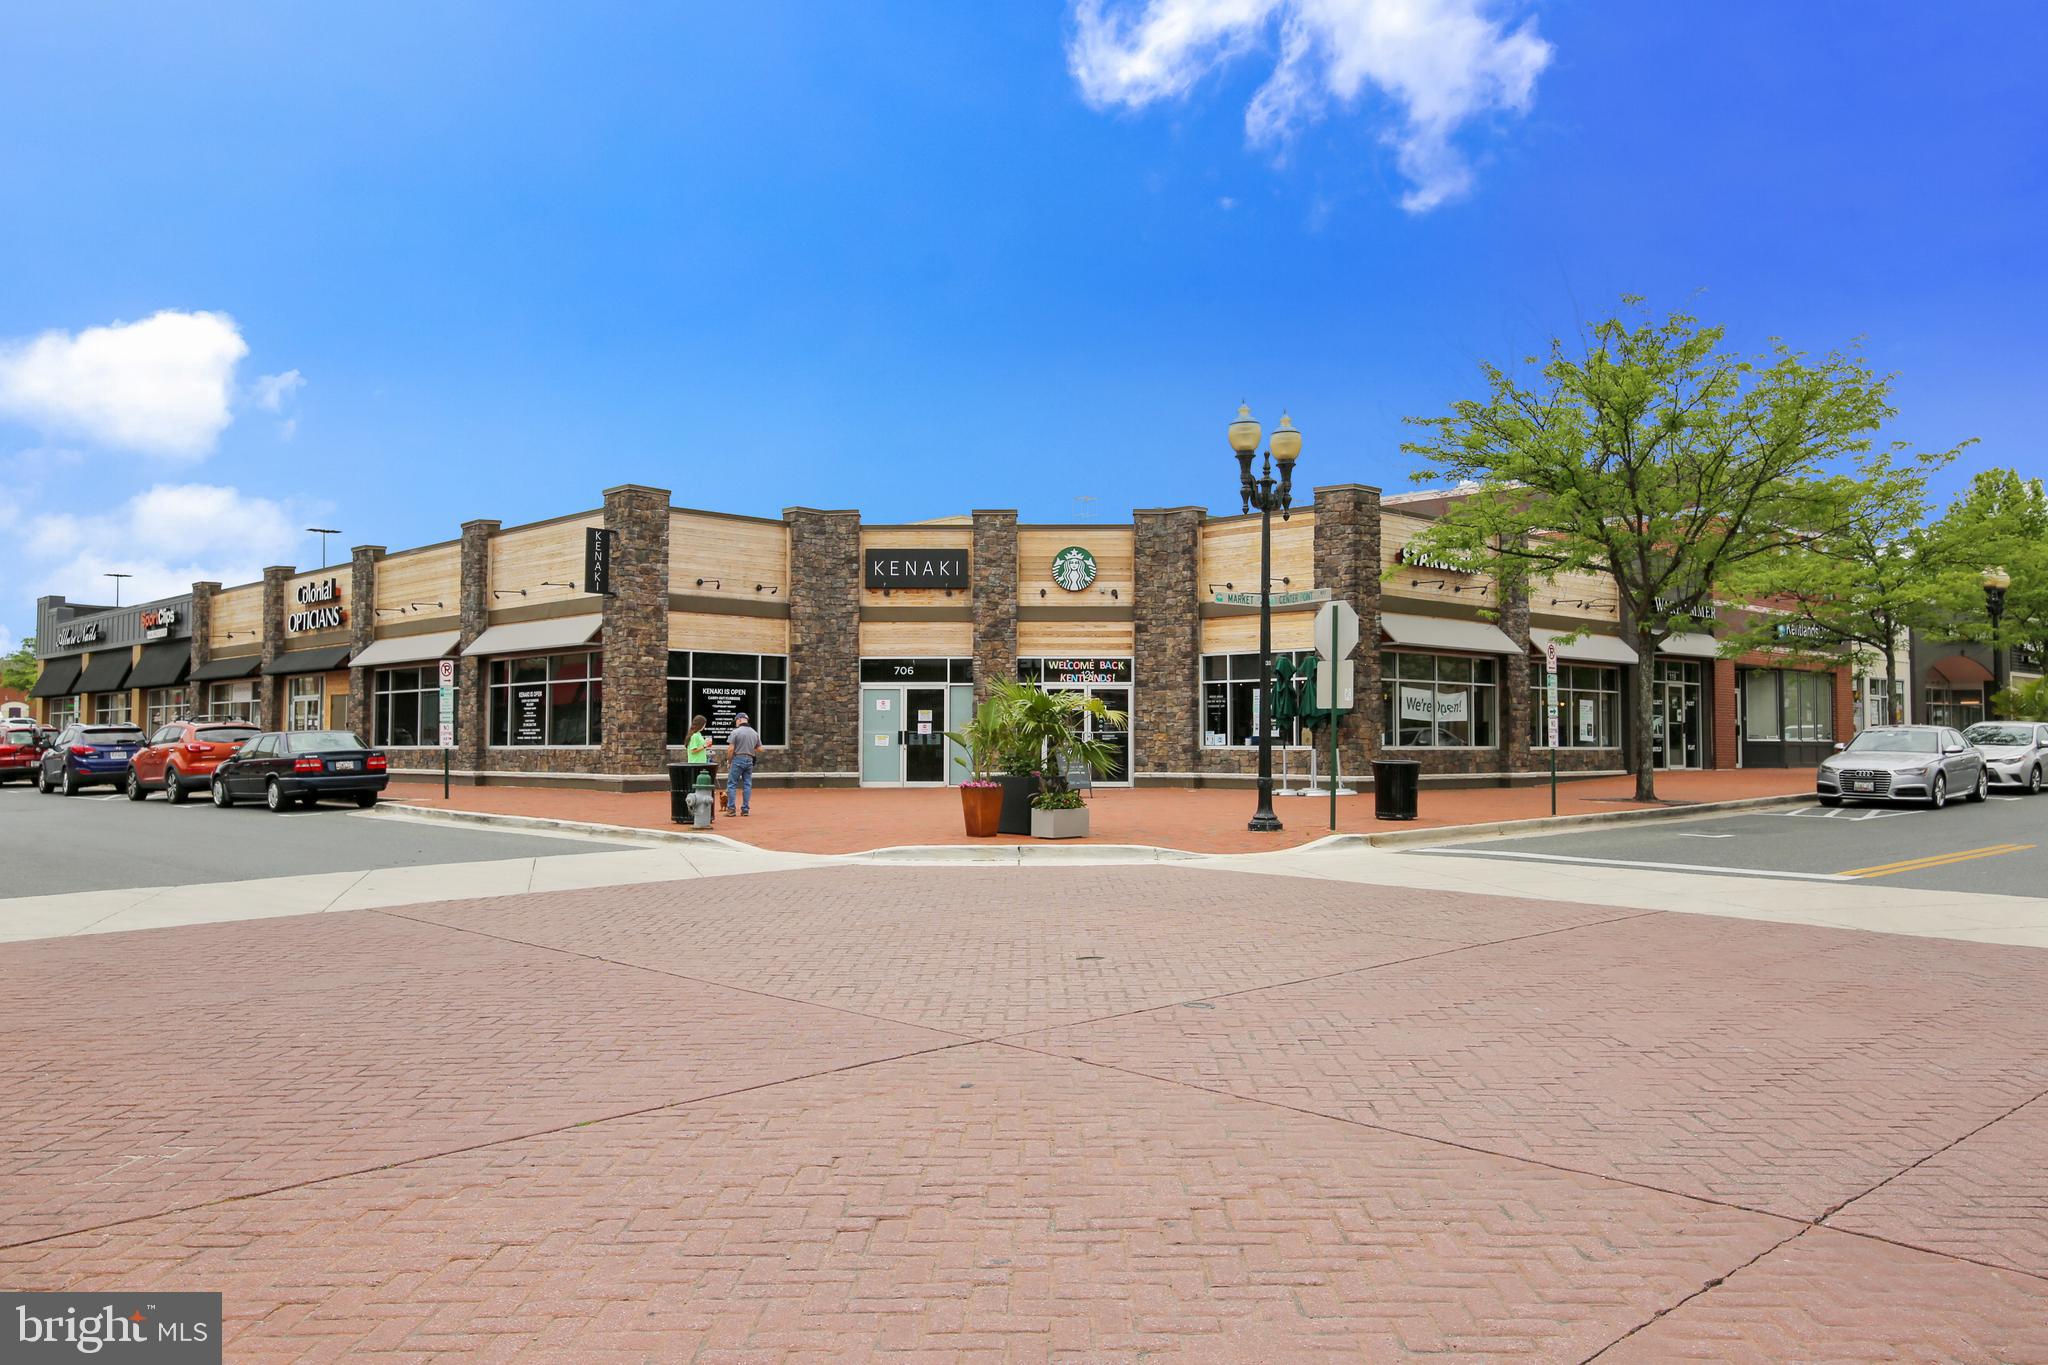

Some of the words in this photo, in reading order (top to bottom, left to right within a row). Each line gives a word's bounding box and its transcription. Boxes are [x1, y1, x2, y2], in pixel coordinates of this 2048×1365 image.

[594, 531, 602, 591] KENAKI
[874, 560, 959, 576] KENAKI
[296, 577, 332, 604] Colonial
[1227, 594, 1254, 605] MARKET
[288, 605, 340, 633] OPTICIANS
[894, 666, 914, 675] 706
[1048, 661, 1095, 670] WELCOME
[1100, 661, 1125, 670] BACK
[1406, 696, 1432, 713] We're
